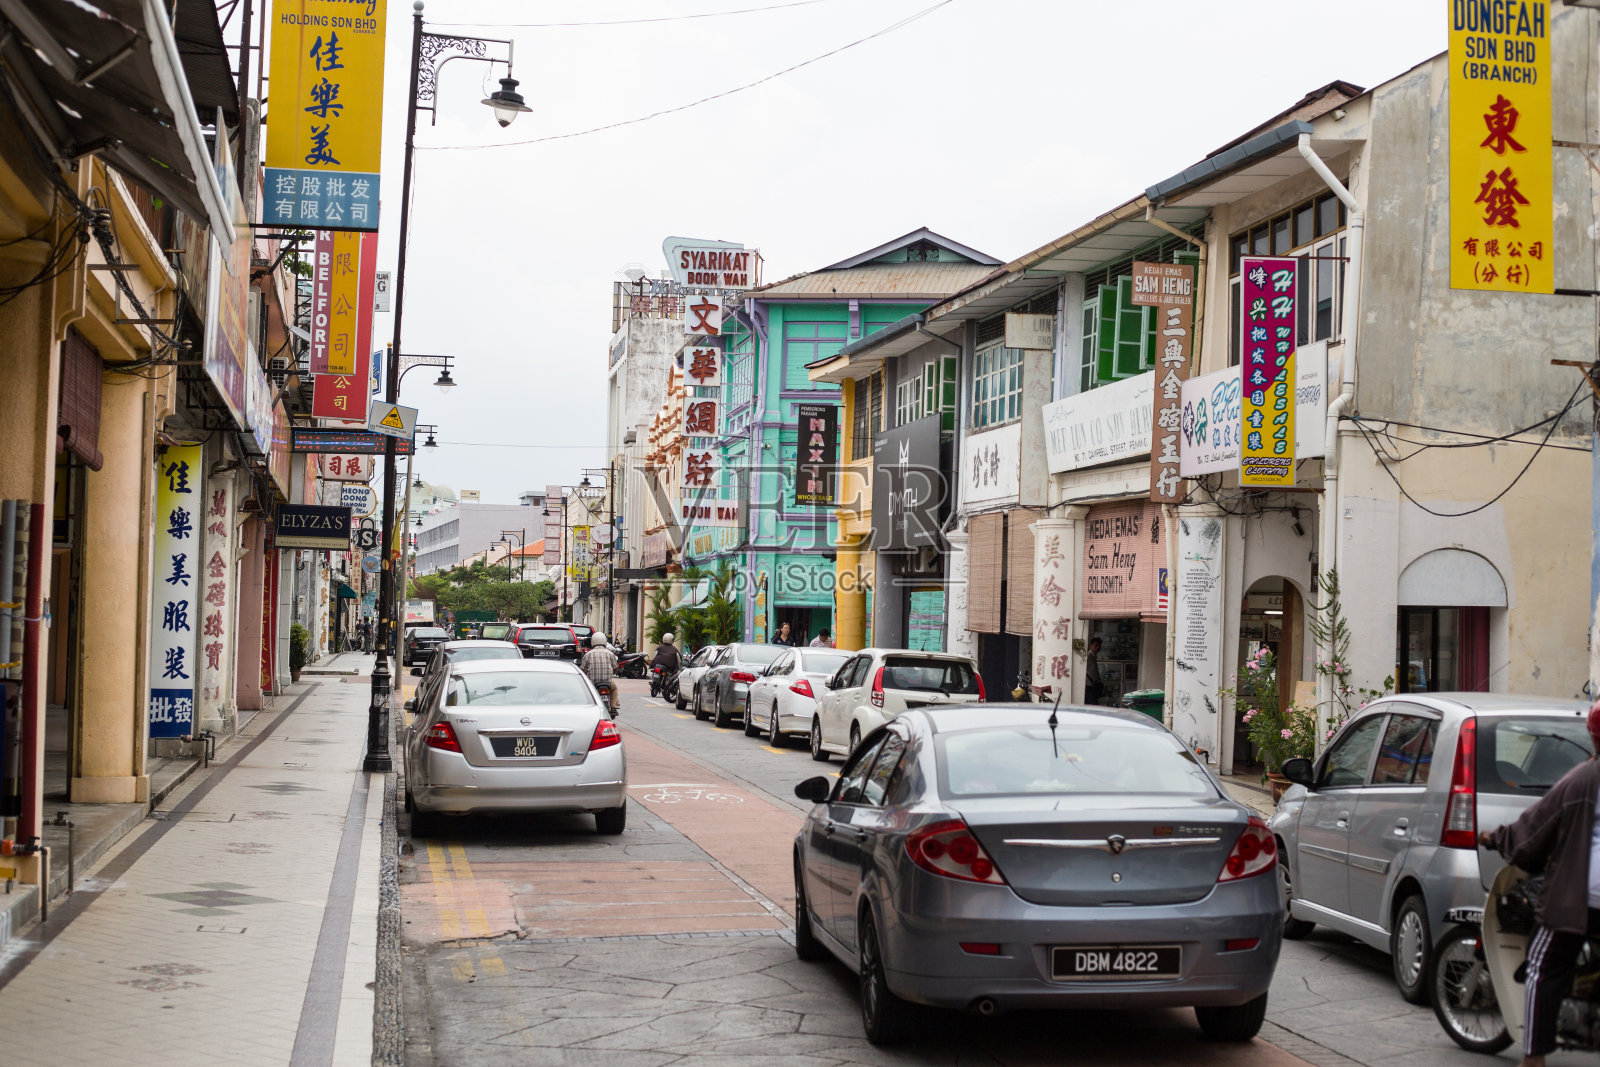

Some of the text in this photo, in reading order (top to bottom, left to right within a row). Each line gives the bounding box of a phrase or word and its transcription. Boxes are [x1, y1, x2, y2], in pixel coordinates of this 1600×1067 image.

[281, 13, 377, 30] HOLDING SDN BHD
[1453, 0, 1546, 38] DONGFAH
[1465, 36, 1536, 63] SDN BHD
[1462, 61, 1538, 85] (BRANCH)
[304, 31, 344, 166] 佳樂美
[1473, 94, 1531, 229] 東發
[275, 173, 371, 200] 控股批发
[274, 198, 370, 222] 有限公司
[1462, 237, 1543, 261] 有限公司
[680, 250, 750, 272] SYARIKAT
[687, 271, 748, 287] BOON WAH
[1473, 262, 1531, 286] (分行)
[1135, 275, 1192, 296] SAM HENG
[314, 251, 330, 358] BELFORT
[1033, 318, 1051, 332] LUN
[1242, 456, 1293, 466] CHILDRENS
[1245, 465, 1289, 478] CLOTHING
[281, 514, 344, 530] ELYZA'S
[682, 505, 711, 519] BOON
[361, 530, 373, 547] S
[1089, 518, 1113, 540] KEDAI
[1115, 515, 1139, 538] EMAS
[1088, 542, 1137, 582] Sam Heng
[1087, 575, 1123, 594] GOLDSMITH
[149, 697, 193, 723] 批發
[514, 746, 537, 757] 9404
[516, 737, 535, 748] WVD
[1075, 952, 1159, 972] DBM 4822
